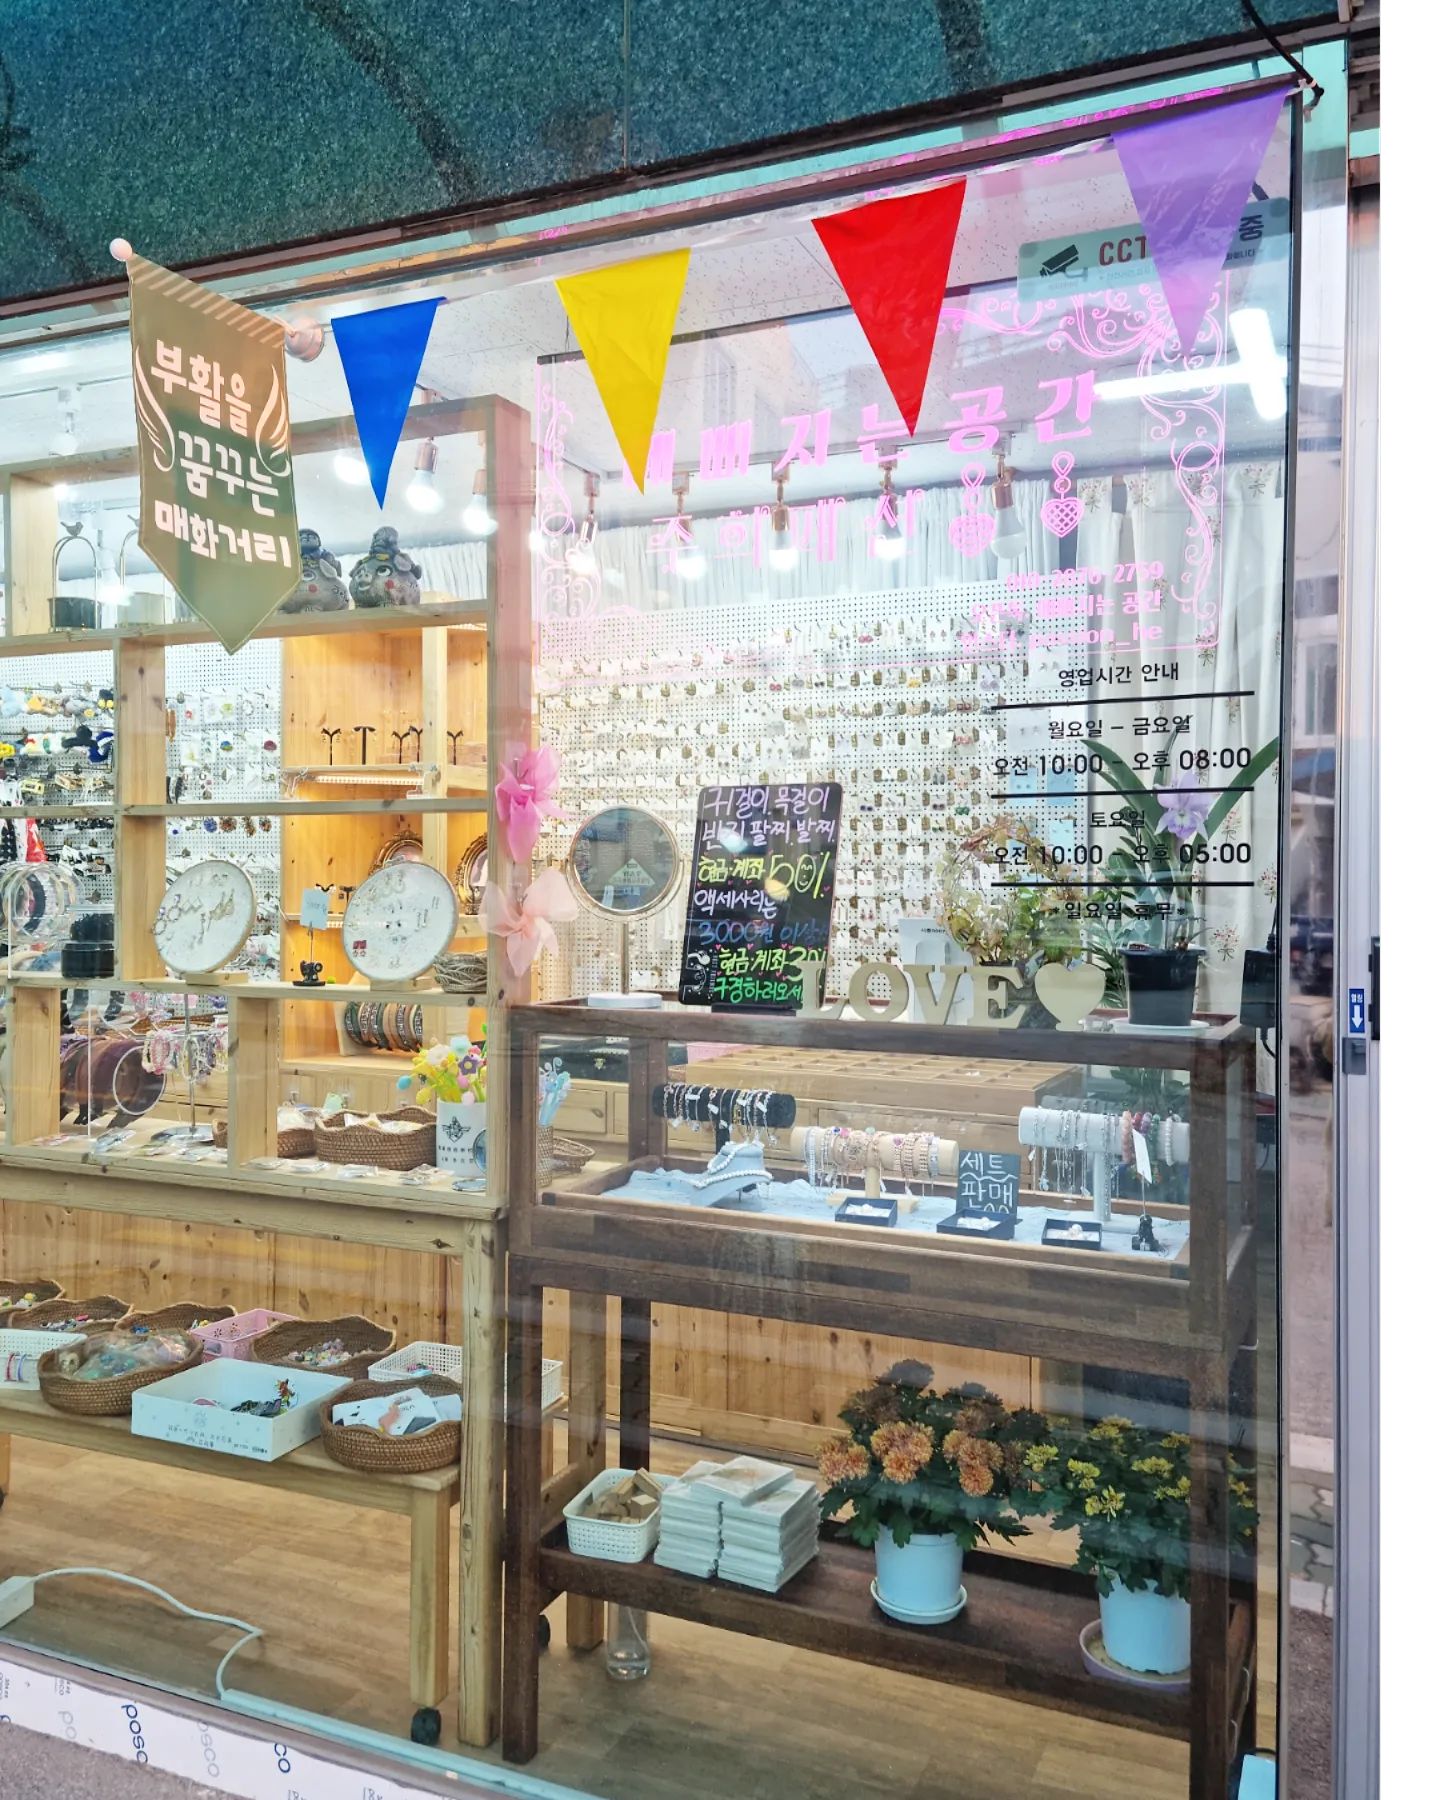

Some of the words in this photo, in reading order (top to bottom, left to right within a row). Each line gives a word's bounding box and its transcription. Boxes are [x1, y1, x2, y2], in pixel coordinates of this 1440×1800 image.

[1099, 235, 1148, 267] CCT
[151, 339, 251, 437] 부활을
[946, 371, 1100, 453] 공간
[178, 430, 279, 516] 꿈꾸는
[155, 499, 291, 568] 매화거리
[1058, 664, 1133, 687] 영업시간
[1141, 662, 1180, 682] 안내
[1048, 719, 1103, 740] 월요일
[1132, 715, 1192, 735] 금요일
[993, 757, 1029, 777] 오전
[1039, 753, 1103, 776] 10:00
[1133, 751, 1171, 772] 오후
[1179, 747, 1252, 770] 08:00
[775, 786, 830, 815] 목걸이
[1090, 811, 1146, 829] 토요일
[993, 846, 1029, 866] 오전
[1039, 844, 1103, 866] 10:00
[1179, 843, 1252, 864] 05:00
[768, 851, 830, 899] 50%
[694, 888, 777, 920] 액세사리는
[796, 960, 1027, 1029] LOVE
[960, 1151, 1006, 1176] 세트
[961, 1180, 1013, 1208] 판매
